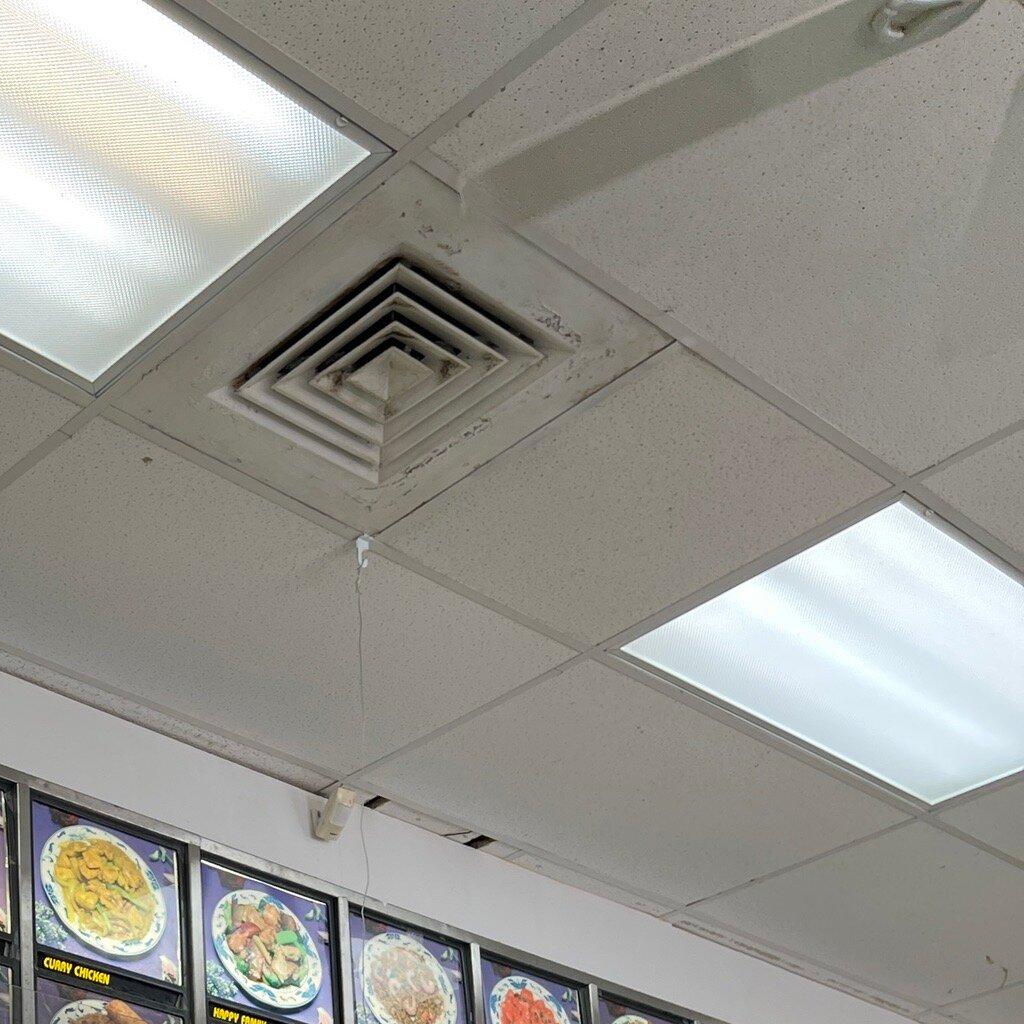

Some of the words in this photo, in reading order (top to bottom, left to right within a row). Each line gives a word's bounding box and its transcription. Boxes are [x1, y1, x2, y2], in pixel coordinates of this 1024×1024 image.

[44, 957, 72, 974] CURRY
[74, 965, 110, 985] CHICKEN
[213, 1007, 239, 1024] HAPPY
